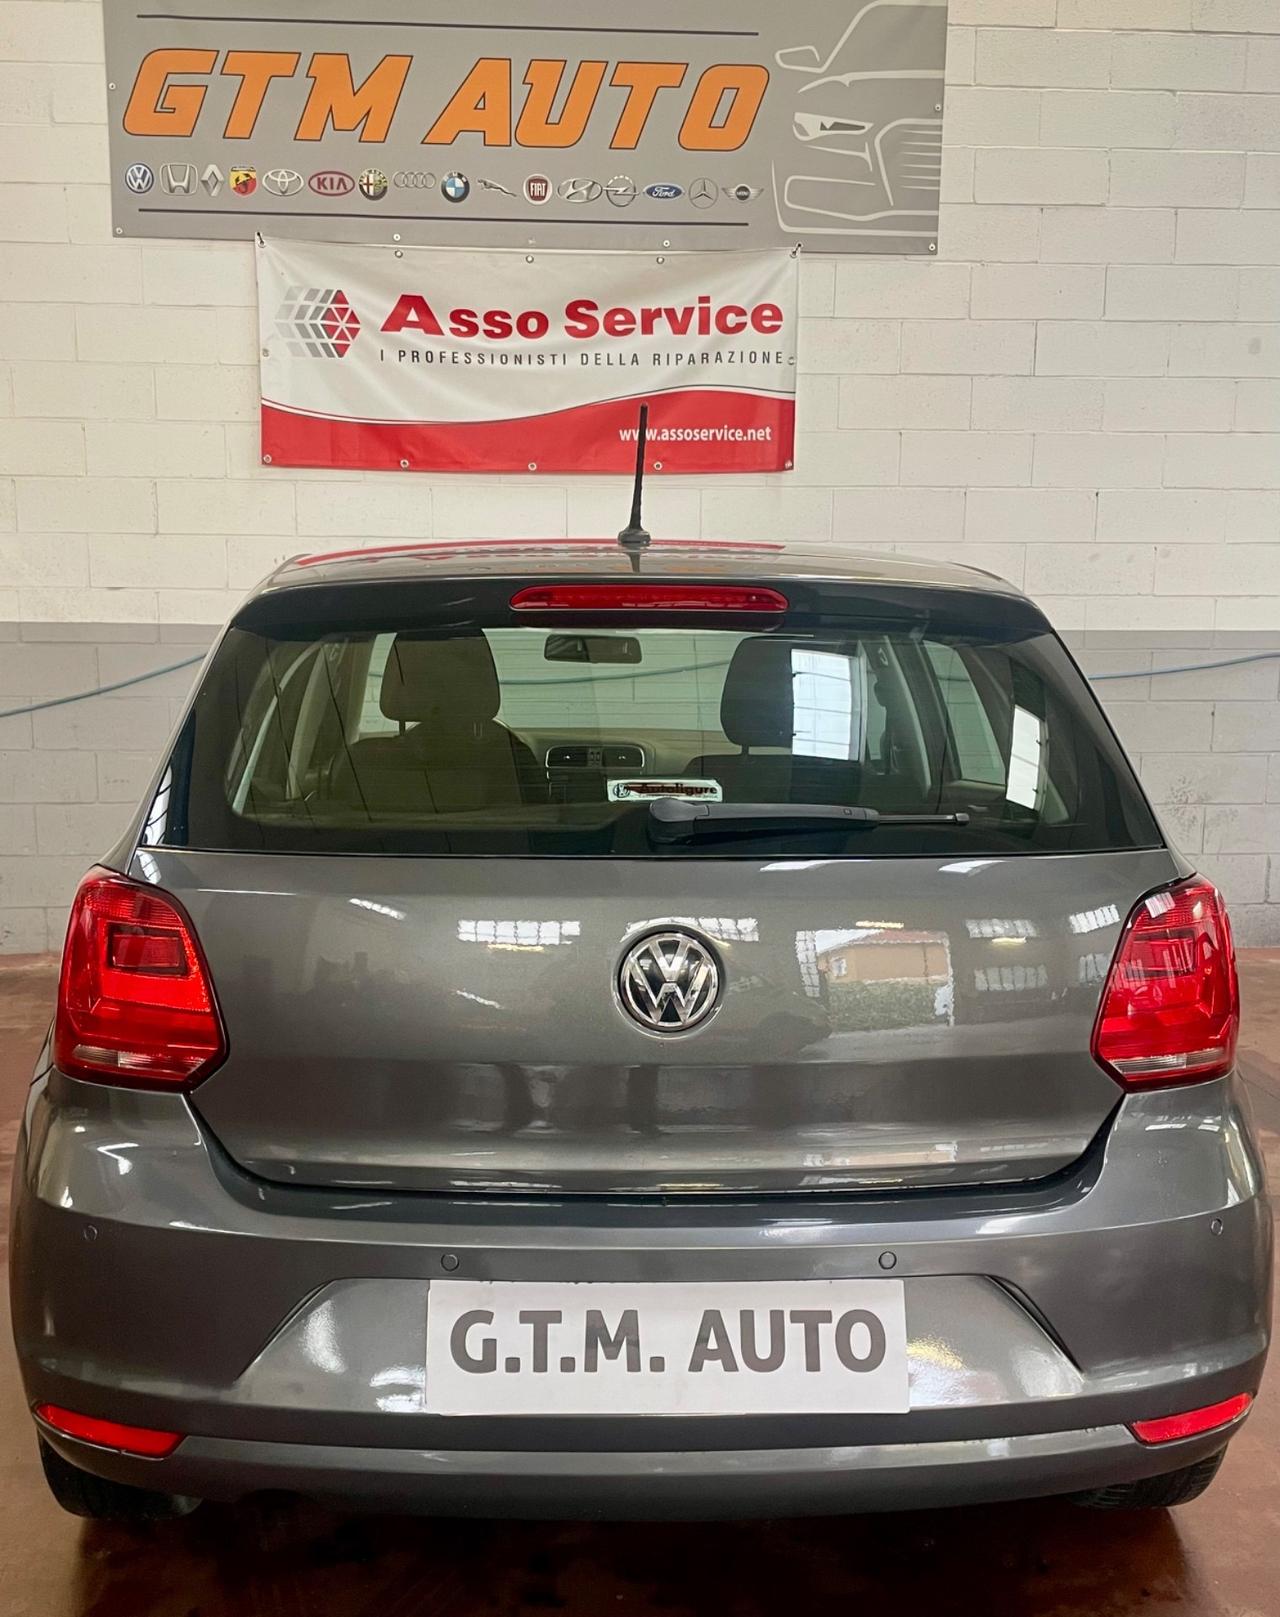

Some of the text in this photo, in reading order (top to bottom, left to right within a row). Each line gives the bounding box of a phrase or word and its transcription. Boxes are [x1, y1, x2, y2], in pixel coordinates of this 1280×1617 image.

[123, 48, 770, 152] GTM AUTO
[316, 177, 348, 191] KIA
[530, 182, 547, 198] FIAT
[652, 187, 676, 197] Ford
[380, 294, 783, 339] Asso Service
[380, 349, 783, 366] I PROFESSIONISTI DELLA RIPARAZIONE
[449, 1309, 886, 1374] G.T.M. AUTO
